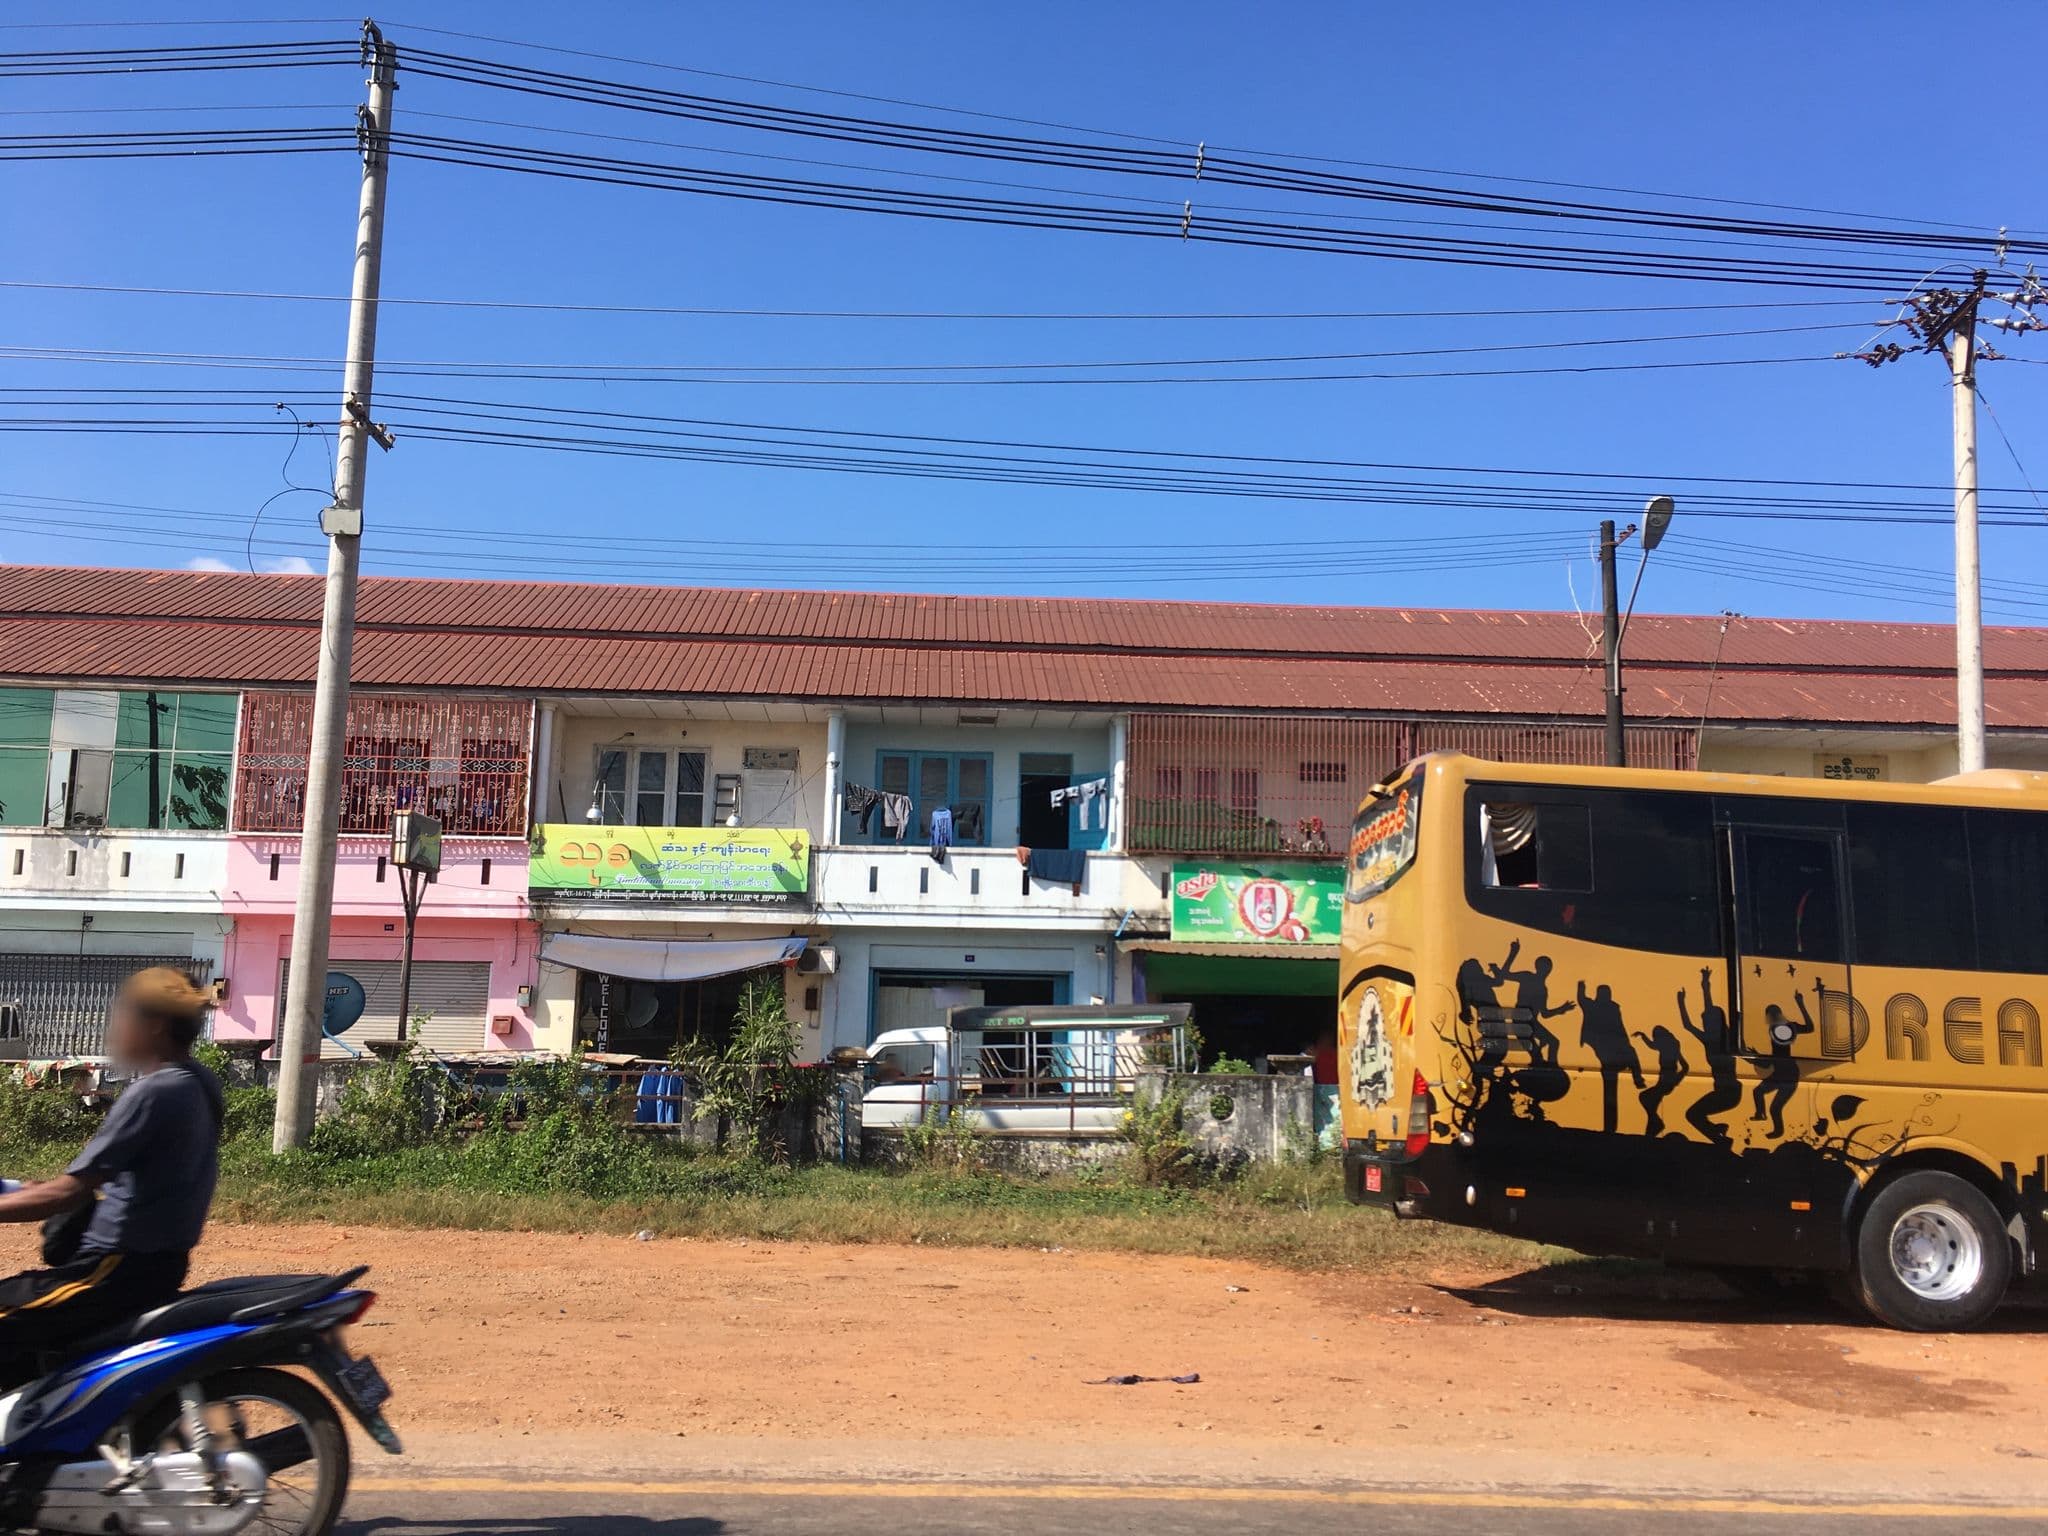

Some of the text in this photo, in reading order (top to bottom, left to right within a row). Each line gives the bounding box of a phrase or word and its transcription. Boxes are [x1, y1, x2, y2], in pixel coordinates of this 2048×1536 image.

[1177, 870, 1217, 894] asia
[597, 974, 610, 1054] WELCOME
[1818, 990, 2044, 1067] DREA
